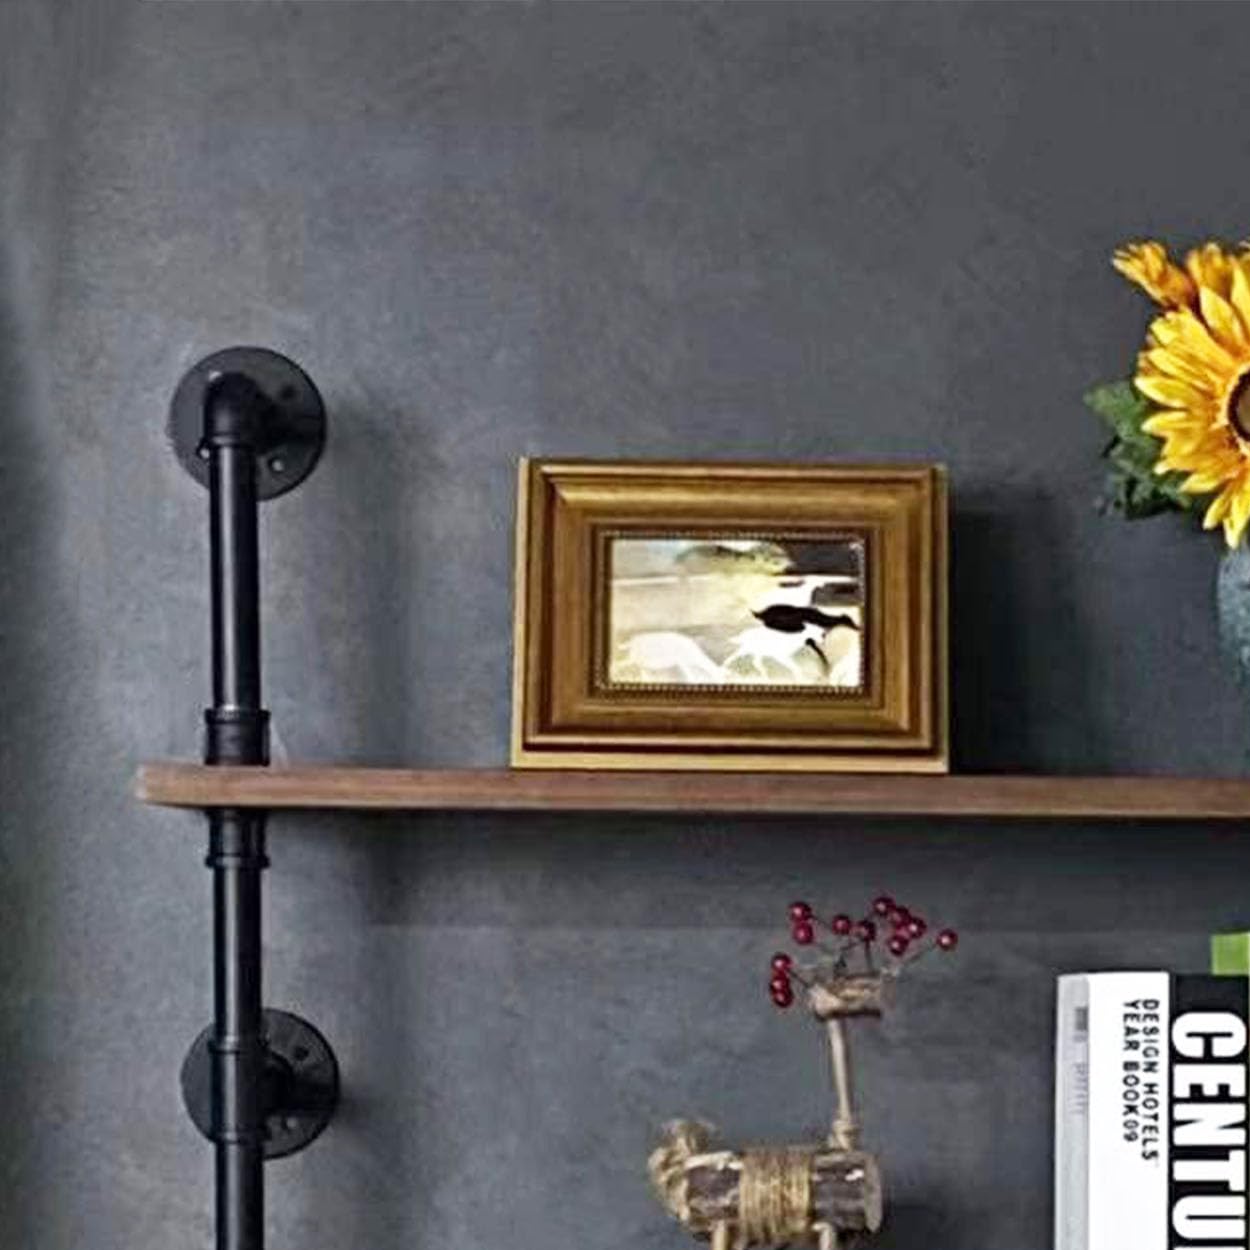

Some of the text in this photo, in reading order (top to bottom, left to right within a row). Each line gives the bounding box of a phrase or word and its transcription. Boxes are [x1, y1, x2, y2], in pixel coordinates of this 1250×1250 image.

[1123, 999, 1141, 1051] YEAR
[1141, 998, 1160, 1161] DESIGN HOTELS
